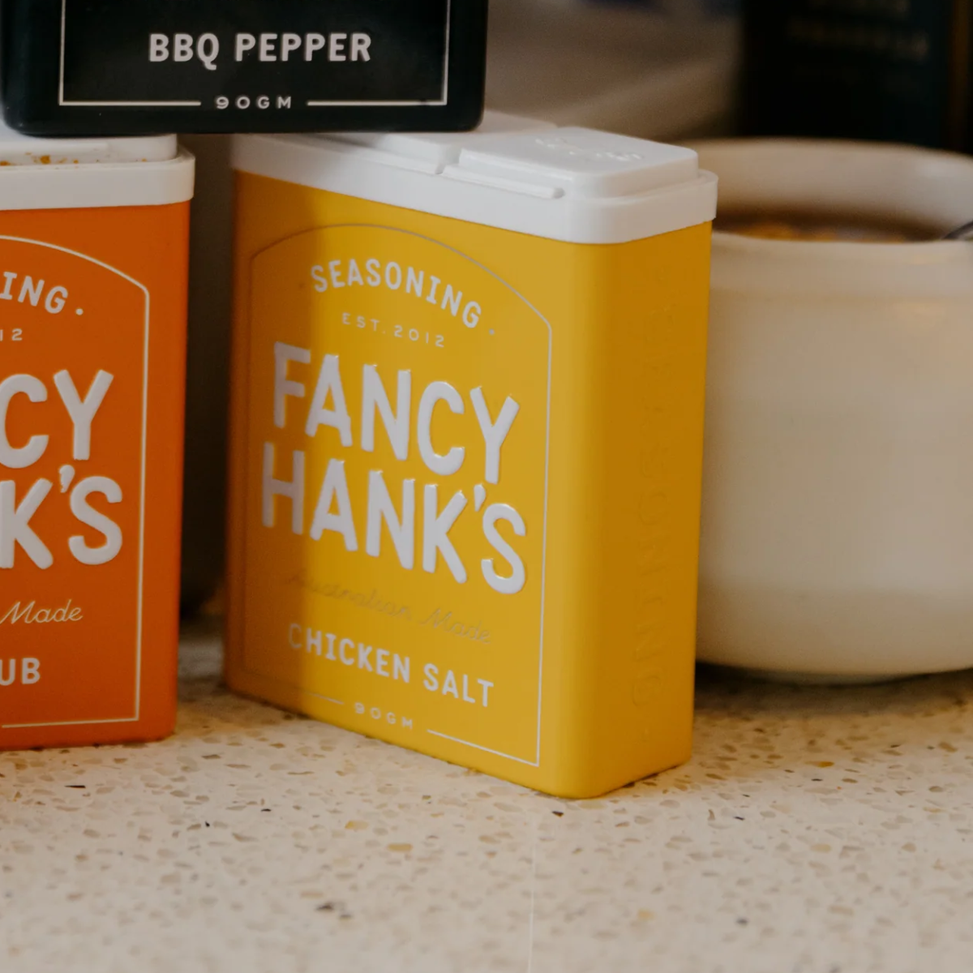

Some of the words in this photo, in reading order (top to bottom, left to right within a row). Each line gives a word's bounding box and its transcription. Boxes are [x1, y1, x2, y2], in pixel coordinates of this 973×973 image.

[148, 32, 220, 71] BBQ
[234, 32, 372, 63] PEPPER
[215, 95, 292, 110] 90GM
[310, 257, 482, 329] SEASONING
[393, 323, 446, 349] 2012
[273, 340, 520, 486] FANCY
[262, 443, 527, 595] HANK'S
[418, 607, 492, 645] Made
[287, 623, 411, 684] CHICKEN
[422, 662, 495, 708] SALT
